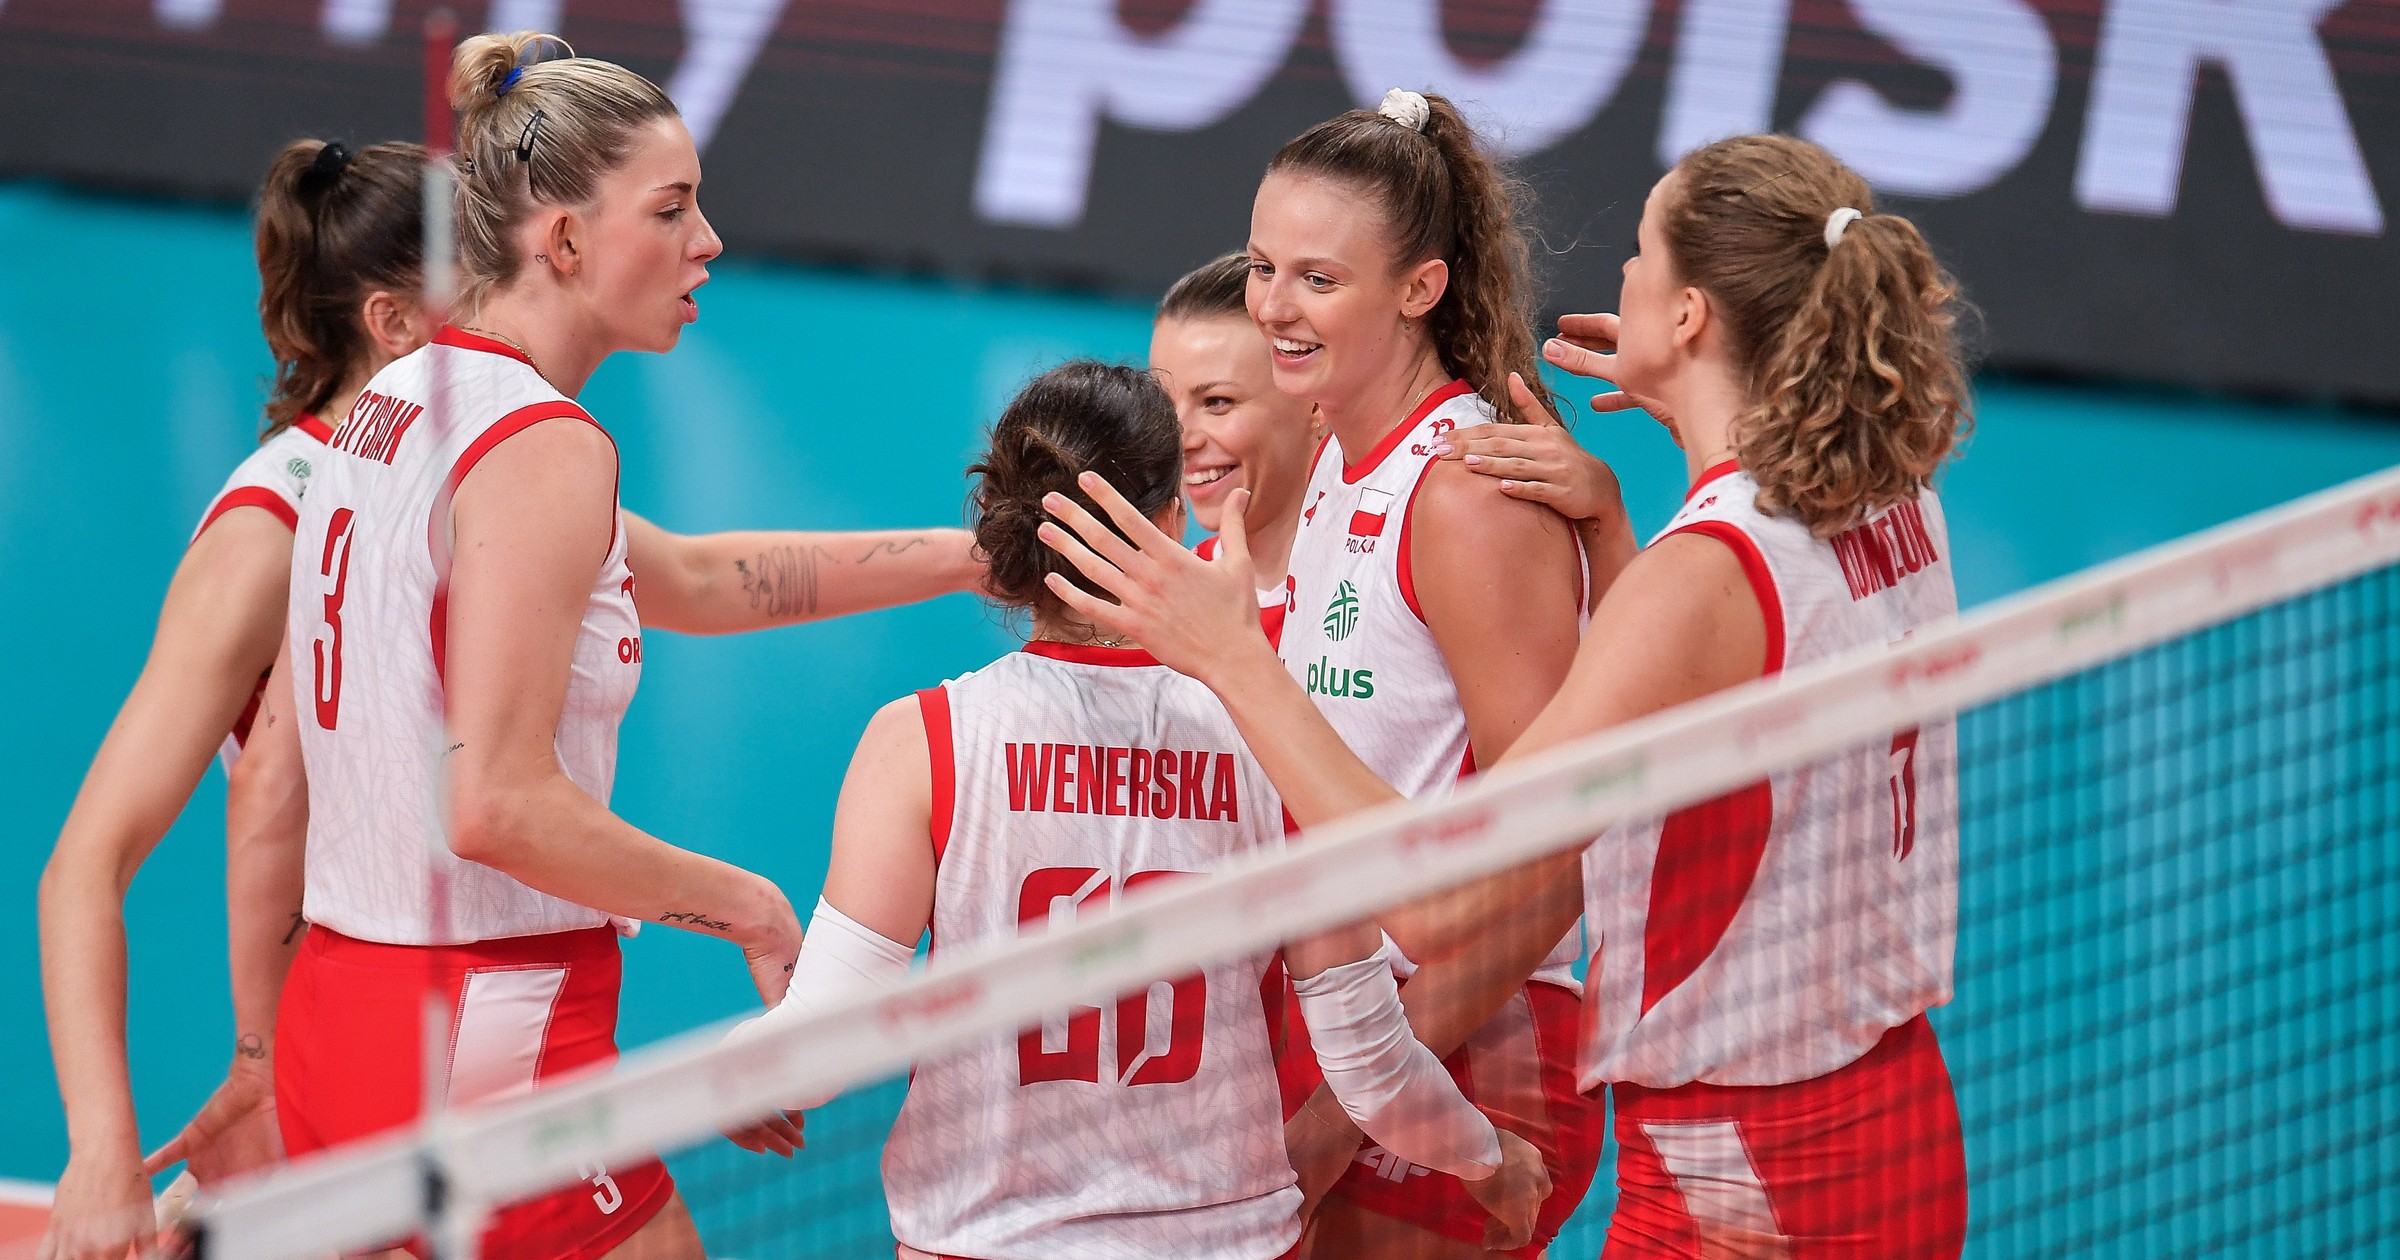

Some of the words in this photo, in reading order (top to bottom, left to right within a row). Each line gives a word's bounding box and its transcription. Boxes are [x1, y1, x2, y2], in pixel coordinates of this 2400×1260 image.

[333, 389, 424, 465] STYSIAK
[314, 507, 356, 730] 3
[1307, 656, 1374, 698] plus
[1005, 742, 1237, 821] WENERSKA
